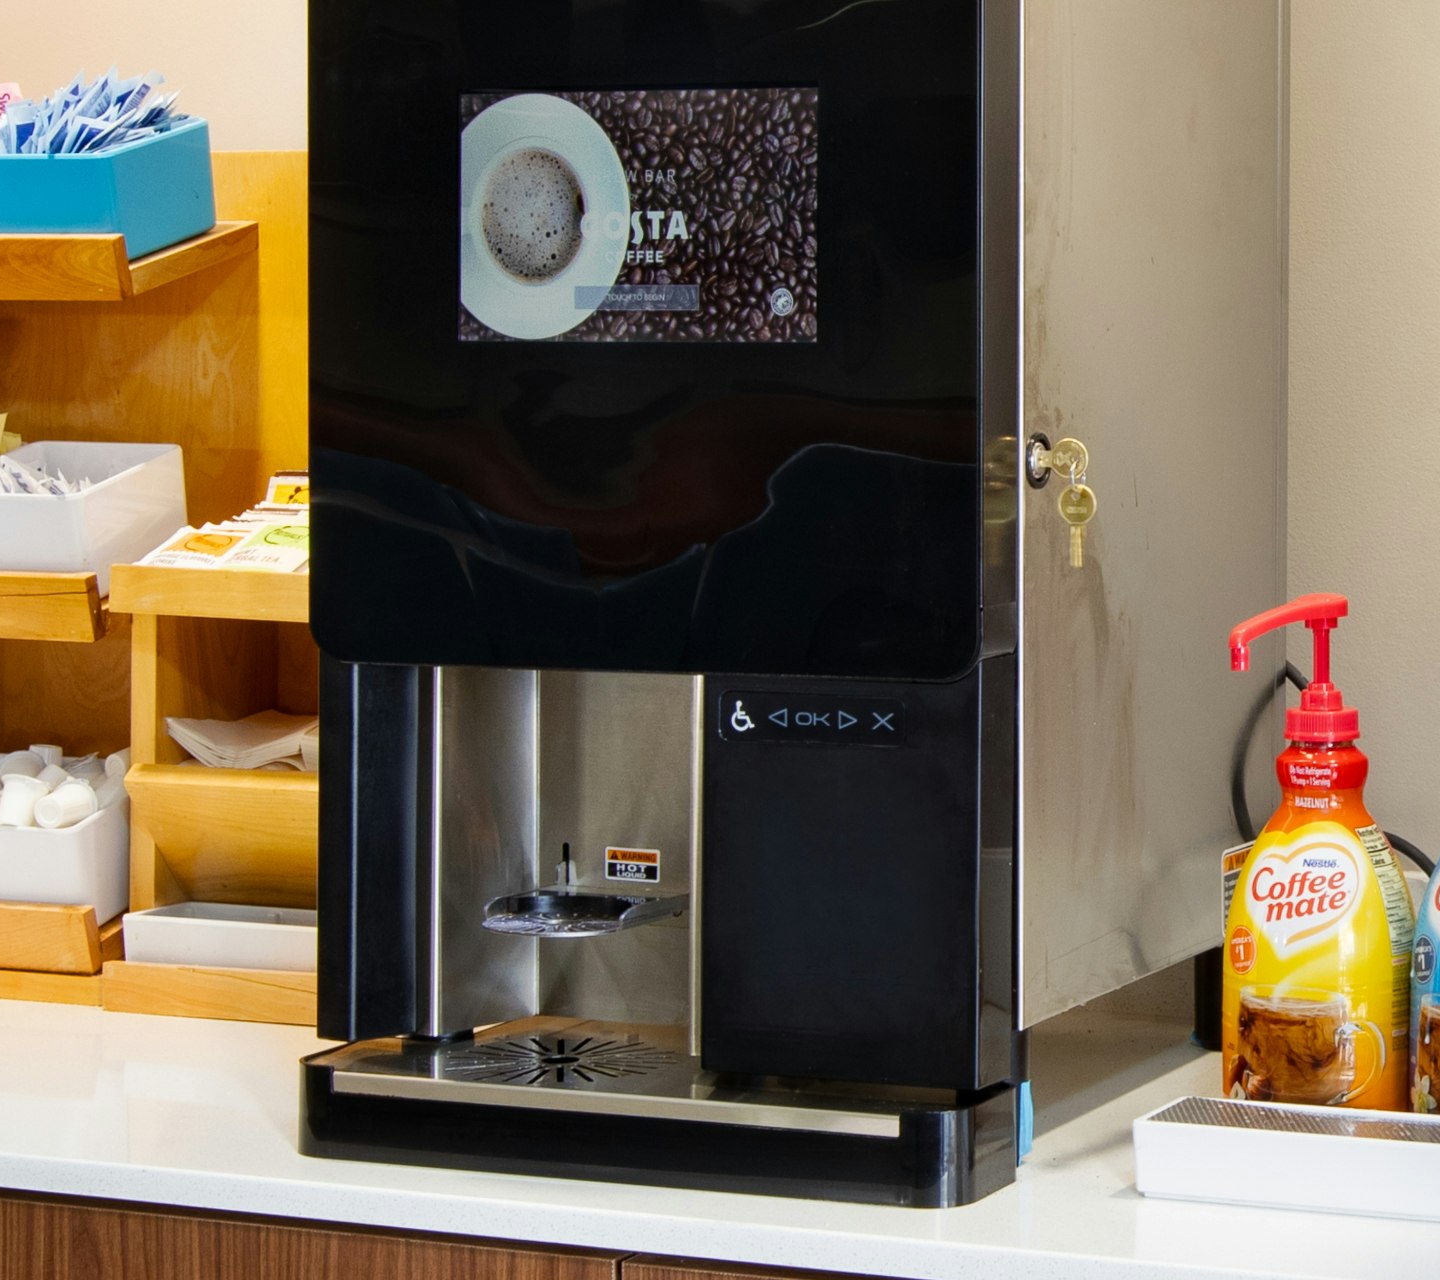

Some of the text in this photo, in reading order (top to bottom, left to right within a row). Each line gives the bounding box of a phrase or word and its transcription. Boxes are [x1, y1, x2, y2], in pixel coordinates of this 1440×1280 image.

[645, 169, 676, 183] BAR
[795, 712, 830, 727] OK
[1305, 766, 1331, 777] Refrigerate
[1312, 778, 1331, 787] Serving
[1295, 796, 1329, 809] HAZELNUT
[616, 863, 647, 873] HOT
[617, 871, 647, 879] LIQUID
[1252, 867, 1346, 902] Coffee
[1266, 890, 1346, 922] mate
